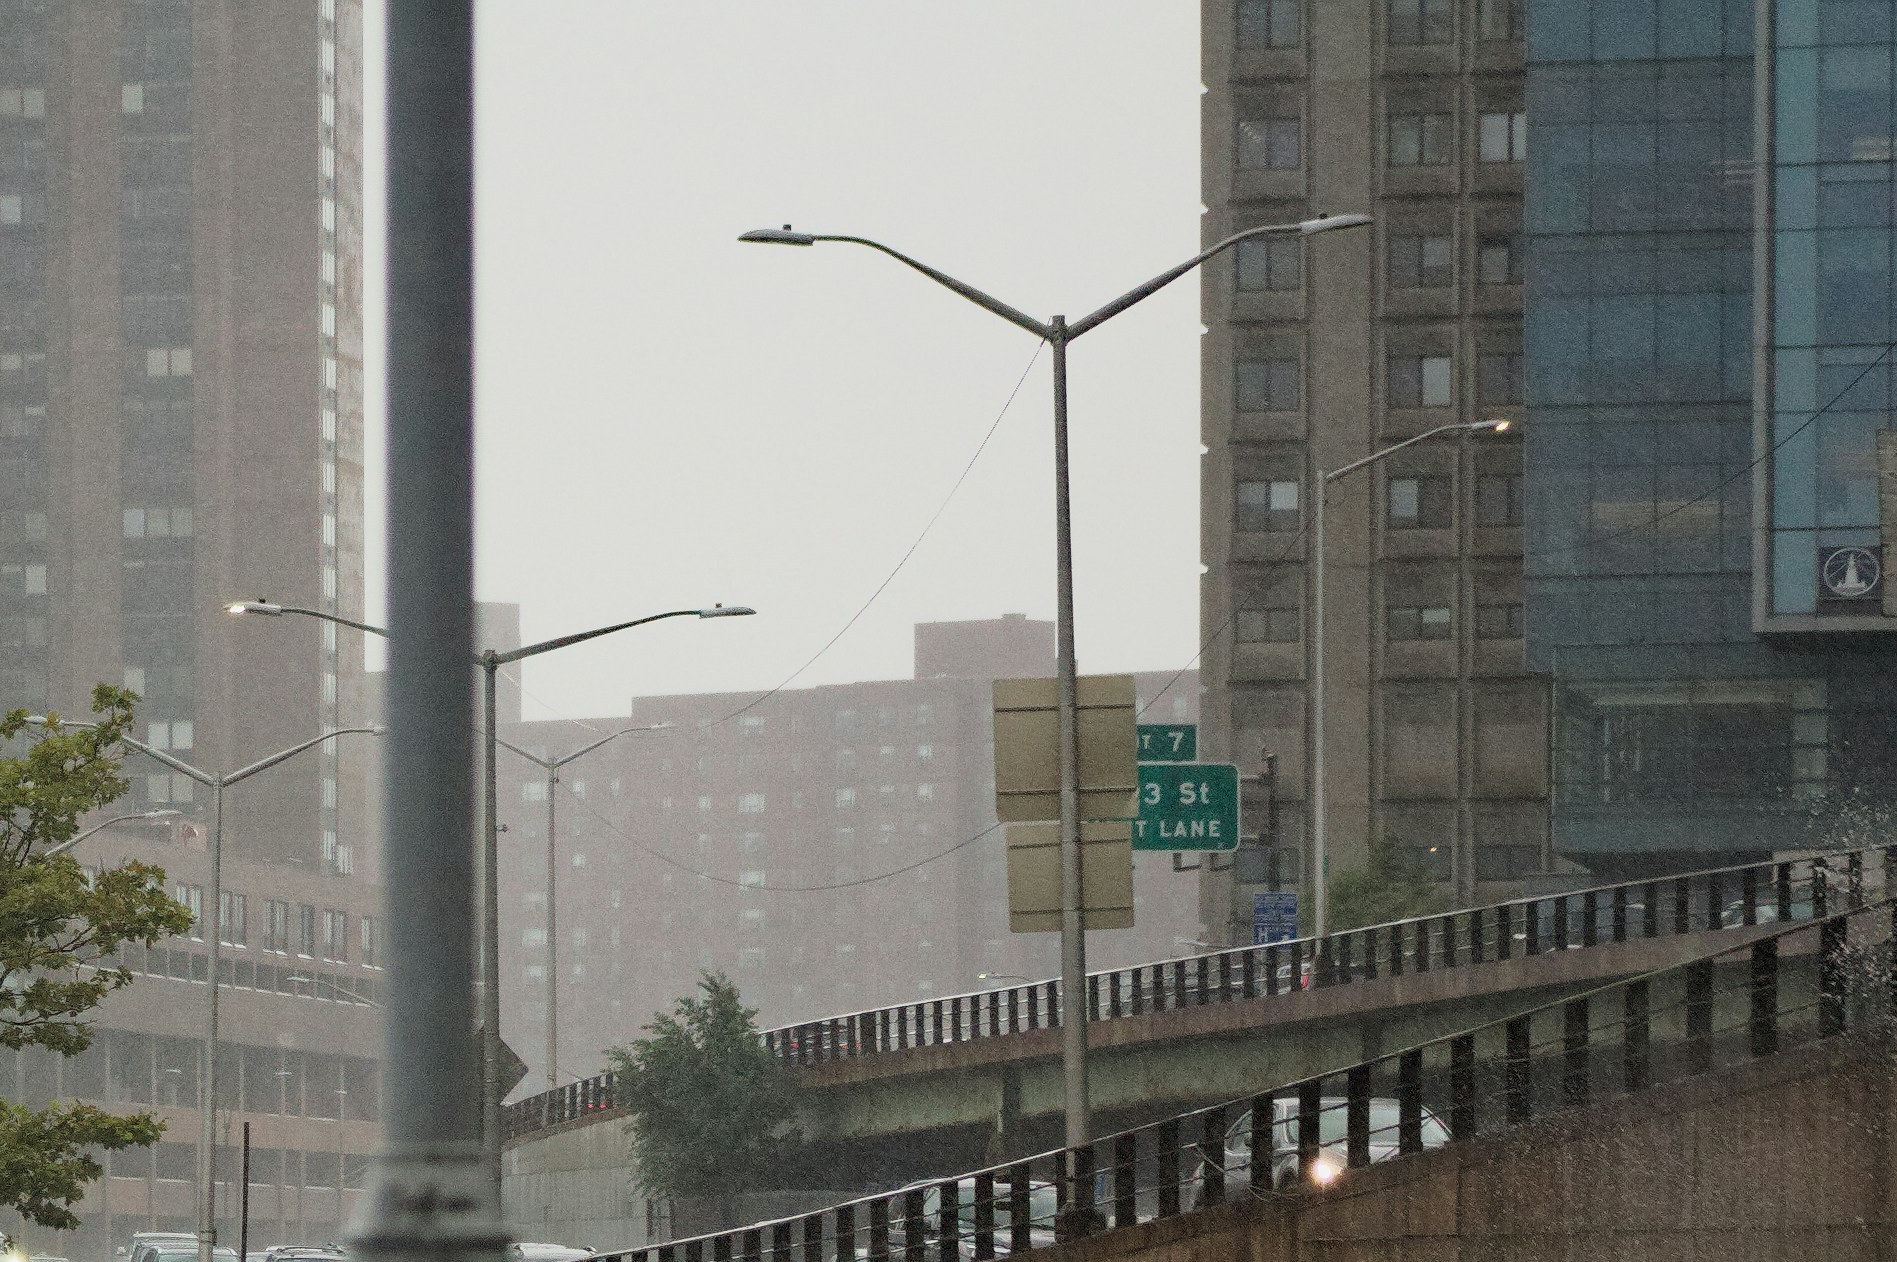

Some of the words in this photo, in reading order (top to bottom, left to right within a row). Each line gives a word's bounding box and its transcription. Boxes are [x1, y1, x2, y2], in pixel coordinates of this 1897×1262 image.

[1167, 732, 1184, 752] 7
[1179, 782, 1209, 805] St
[1159, 820, 1221, 838] LANE
